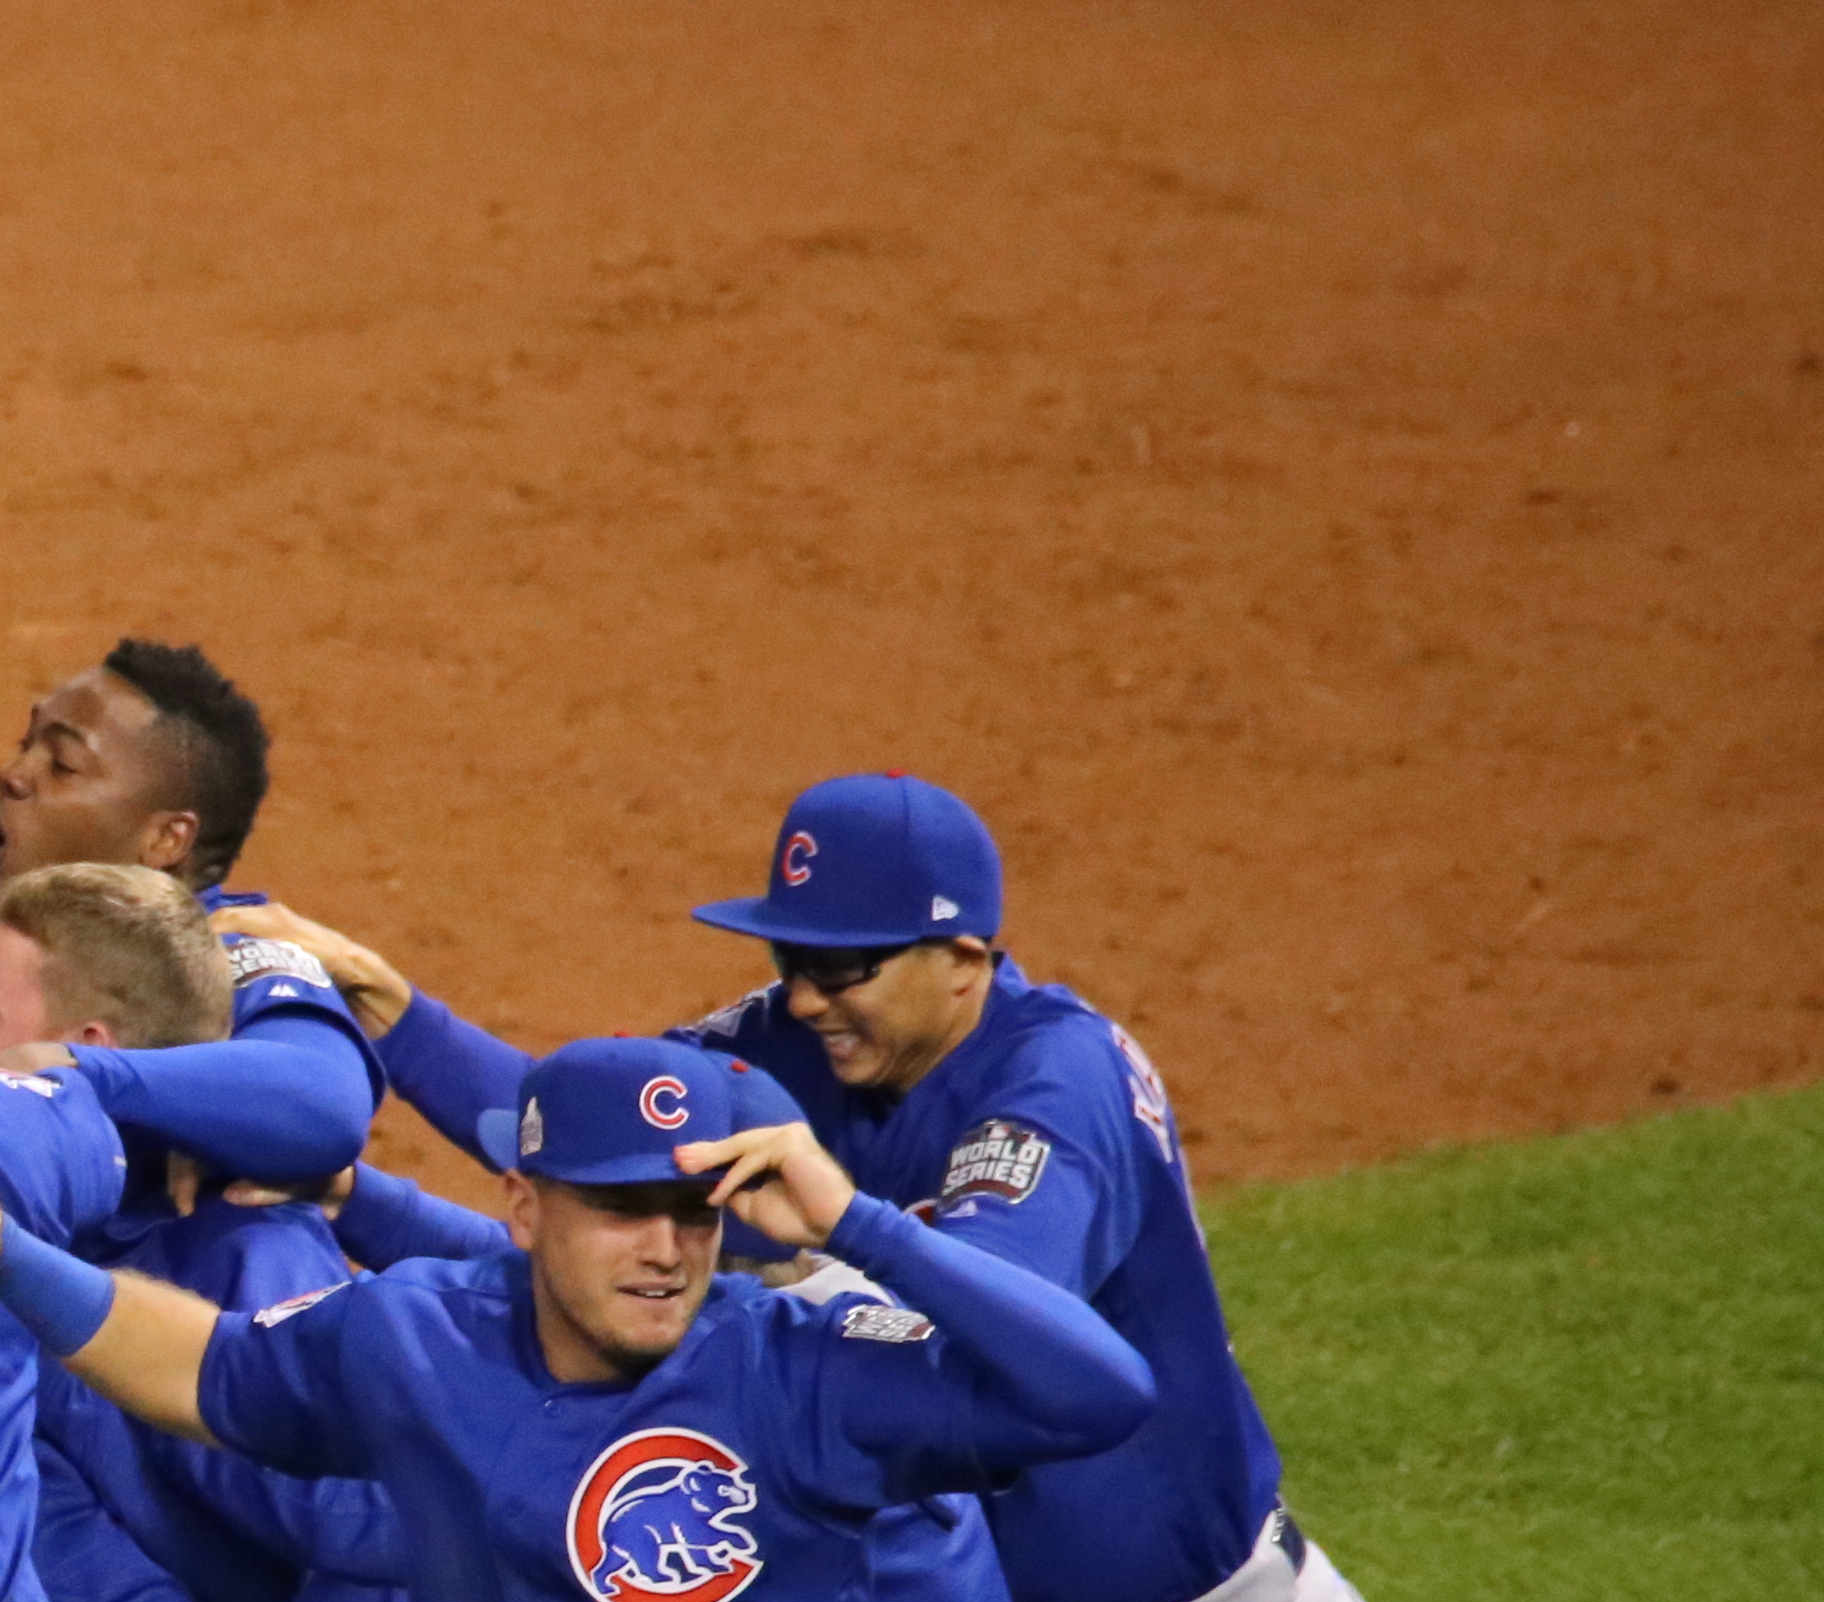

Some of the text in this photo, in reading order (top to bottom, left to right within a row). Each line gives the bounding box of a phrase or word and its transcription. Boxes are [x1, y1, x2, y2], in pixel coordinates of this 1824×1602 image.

[780, 829, 818, 887] C
[638, 1075, 690, 1130] C
[944, 1160, 1033, 1190] SERIES
[950, 1139, 1041, 1169] WORLD
